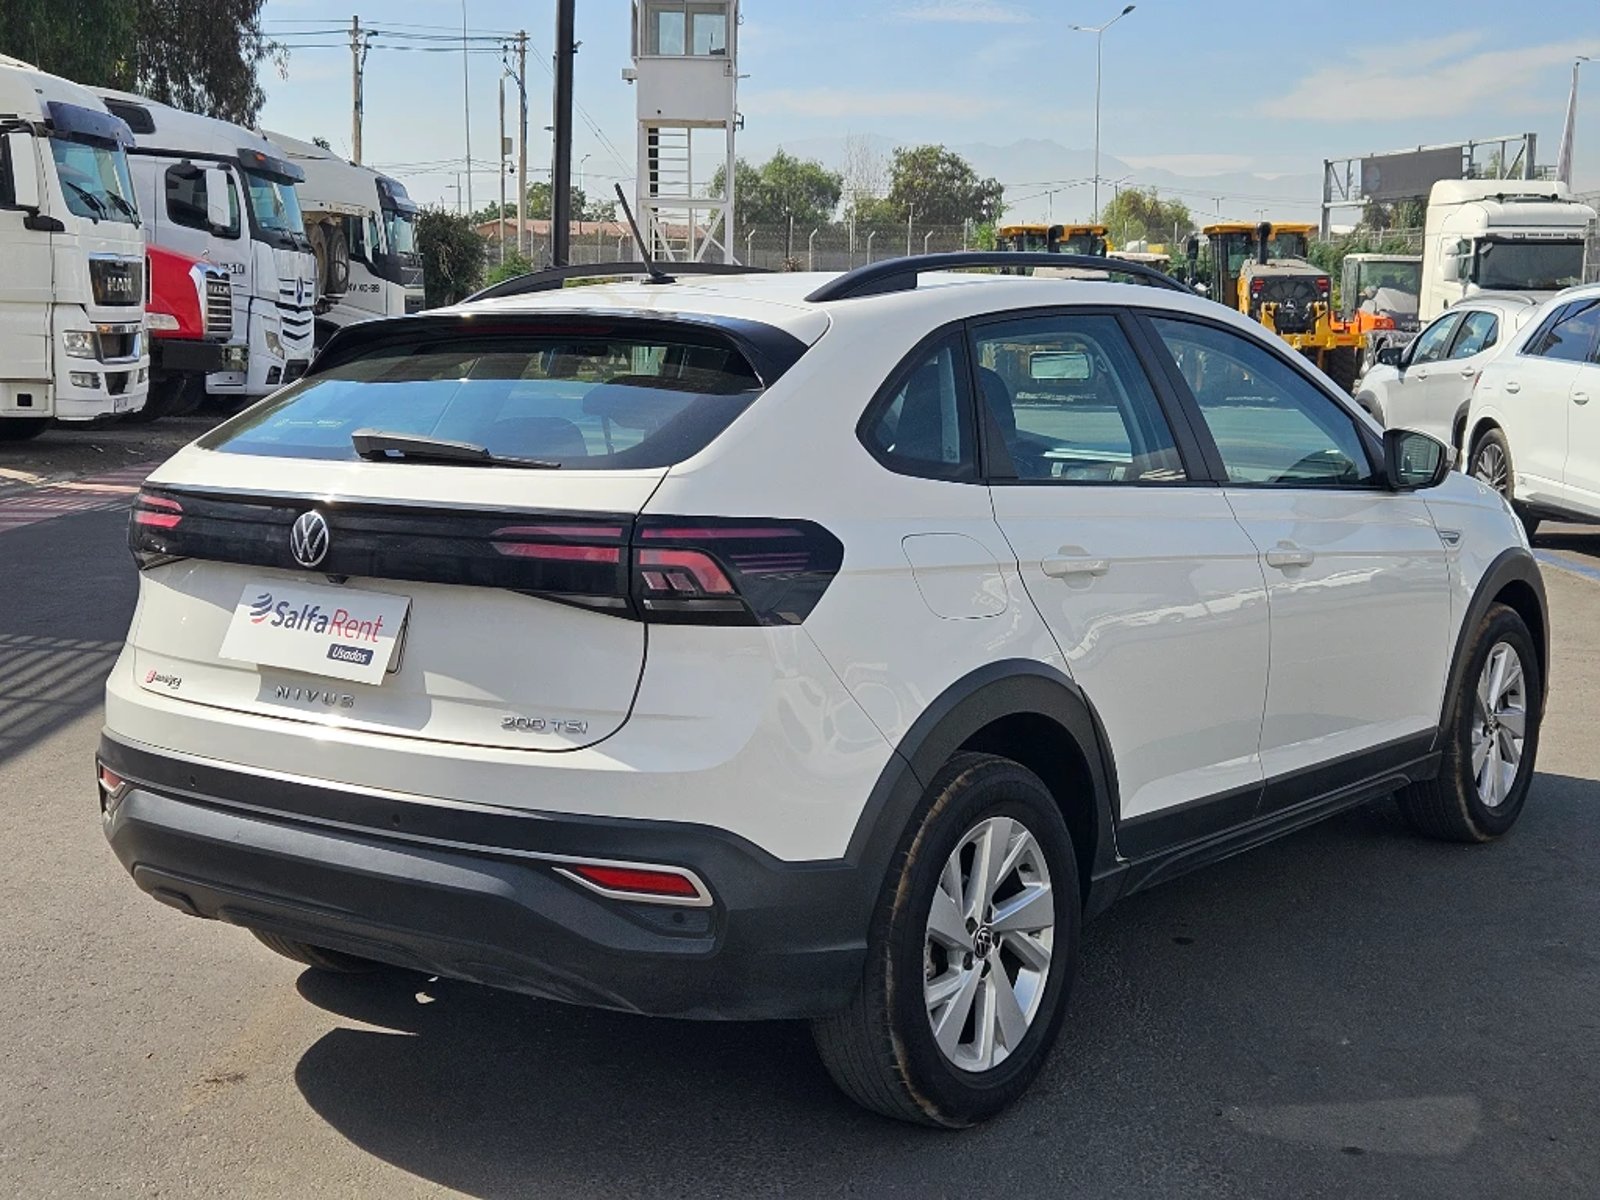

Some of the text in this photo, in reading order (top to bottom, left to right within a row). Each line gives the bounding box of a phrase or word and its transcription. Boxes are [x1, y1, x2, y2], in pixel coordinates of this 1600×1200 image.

[270, 601, 384, 643] SalfaRent
[332, 646, 367, 664] Usados
[275, 684, 356, 708] NIVUS
[501, 716, 588, 735] 200 TSI
